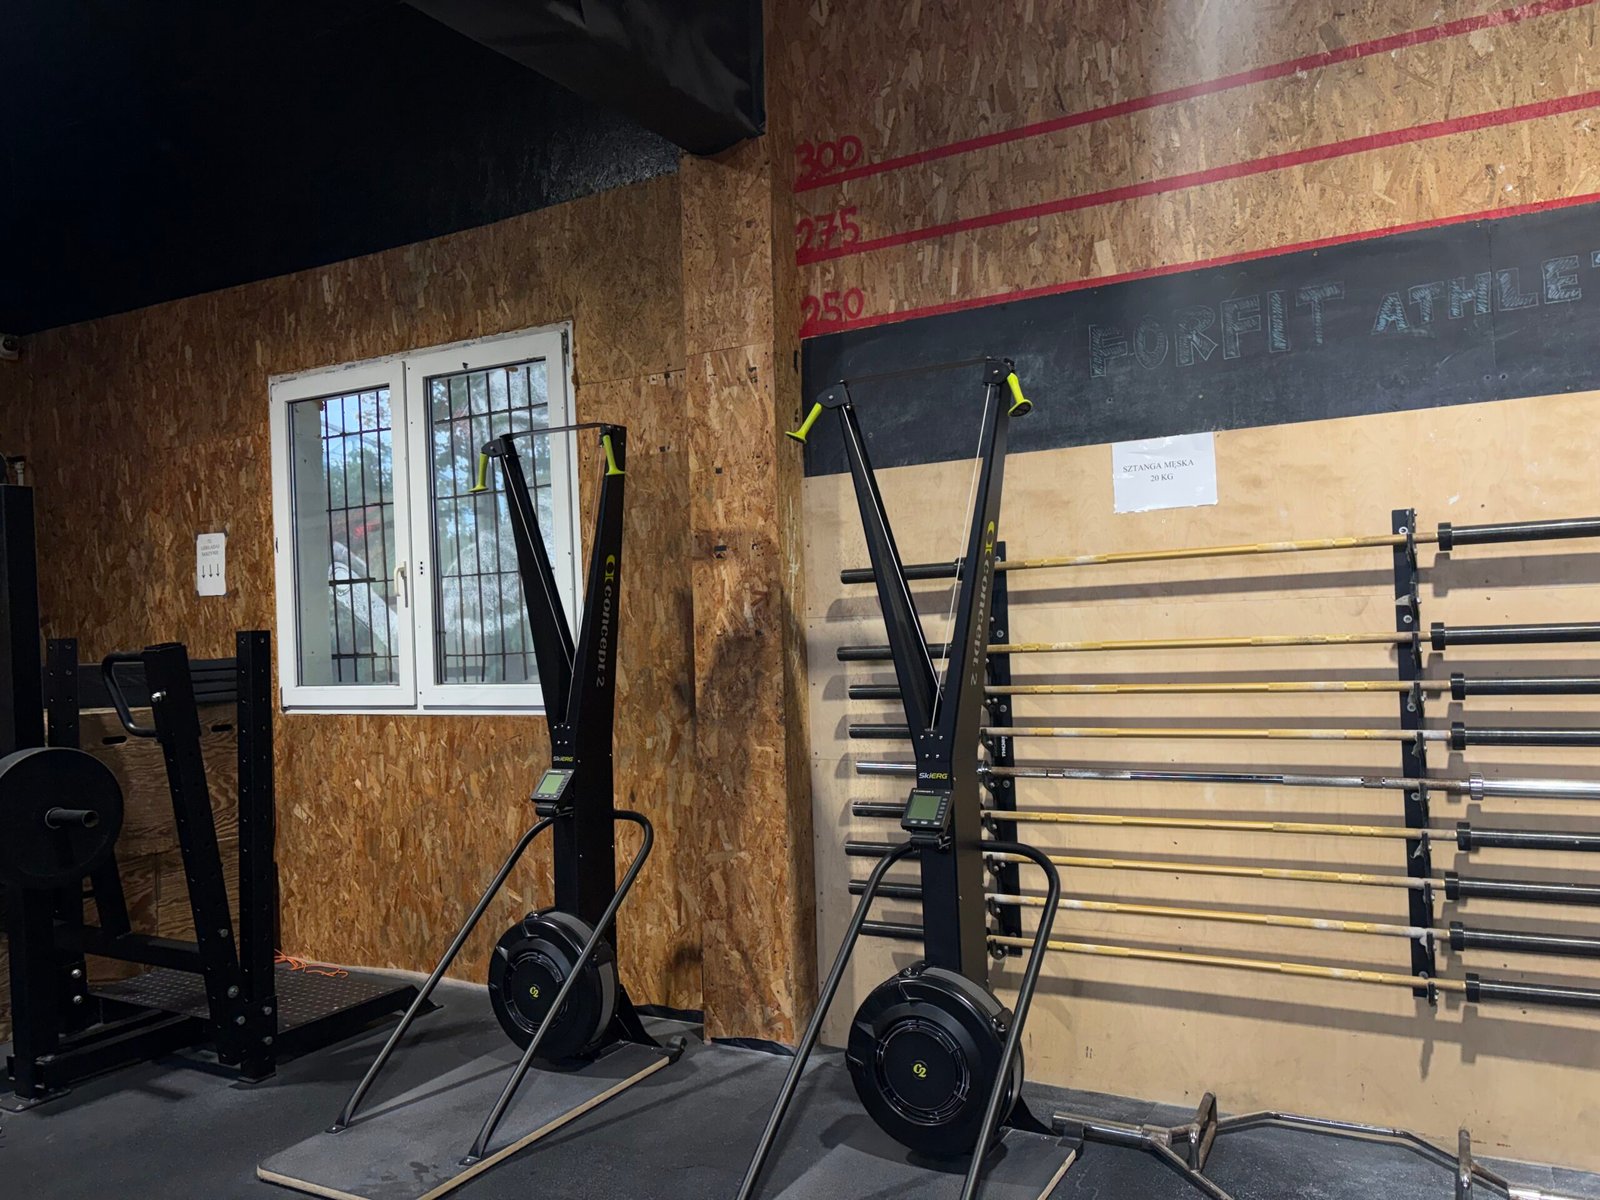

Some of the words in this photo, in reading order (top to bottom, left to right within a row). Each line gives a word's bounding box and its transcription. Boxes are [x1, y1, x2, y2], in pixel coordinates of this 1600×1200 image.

[795, 135, 863, 179] 300
[794, 206, 861, 251] 275
[800, 287, 865, 325] 250
[1088, 281, 1344, 378] FORFIT
[1371, 250, 1600, 335] ATHLE
[1123, 463, 1162, 473] SZTANGA
[1164, 459, 1194, 469] MĘSKA
[1150, 474, 1160, 482] 20
[1161, 473, 1174, 481] KG
[597, 584, 613, 672] concept
[972, 559, 990, 667] concept
[596, 677, 605, 688] 2
[970, 672, 978, 686] 2
